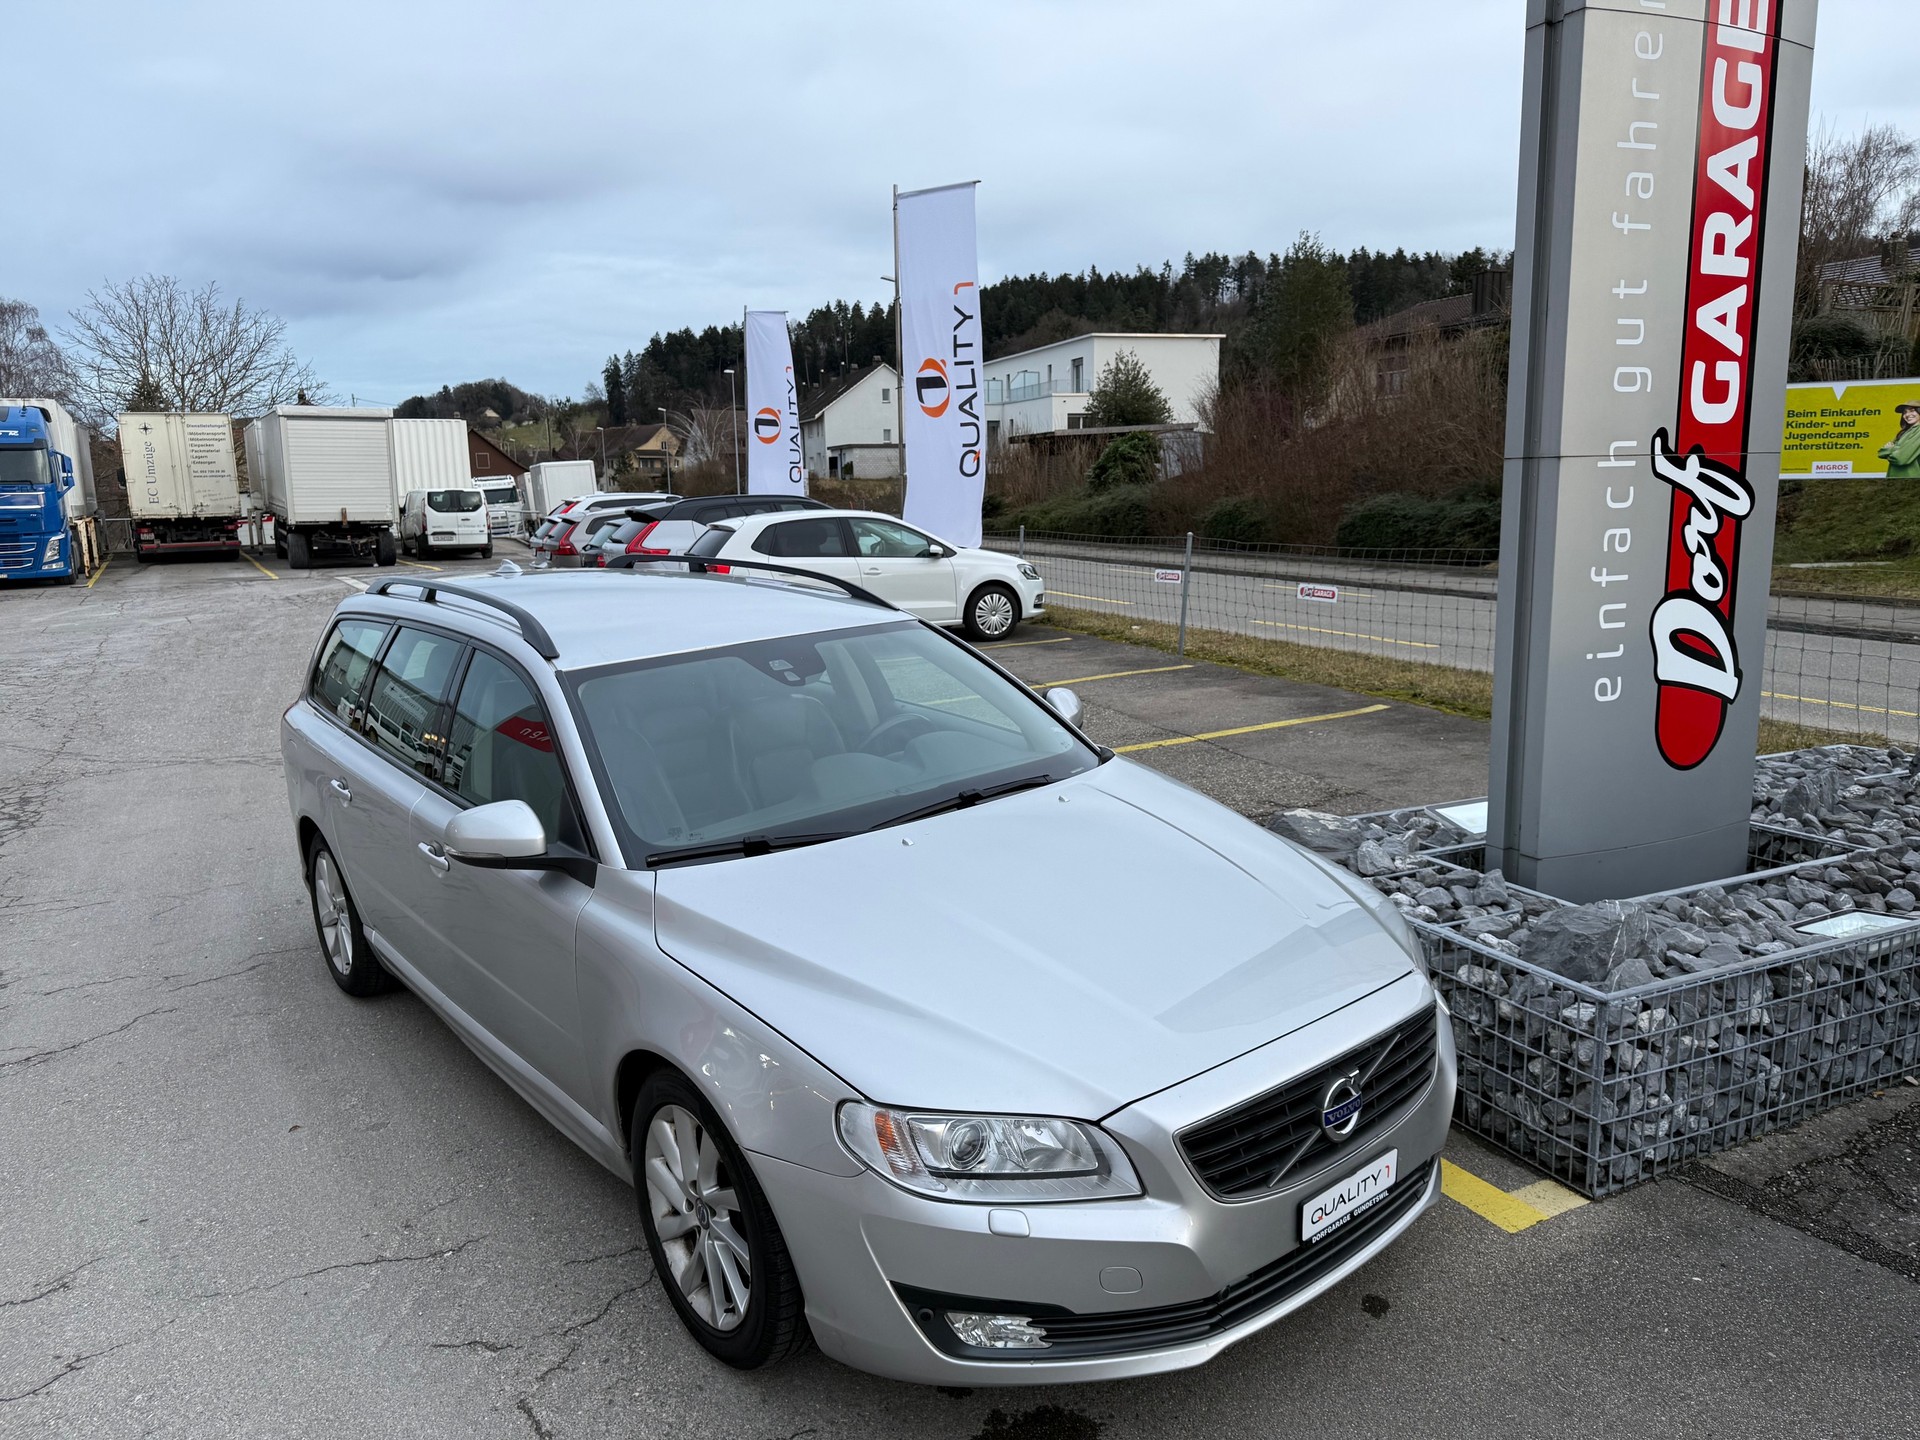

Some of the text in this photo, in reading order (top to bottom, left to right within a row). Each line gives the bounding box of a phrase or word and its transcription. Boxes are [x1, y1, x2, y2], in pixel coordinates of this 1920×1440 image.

[1611, 279, 1653, 393] gut
[1651, 0, 1770, 701] Dorf GARAGE
[953, 281, 981, 478] QUALITY 1
[1785, 431, 1870, 441] Jugendcamps
[1786, 419, 1856, 429] Kinder- und
[1787, 407, 1881, 418] Beim Einkaufen
[143, 441, 160, 504] EC Umzüge
[1784, 441, 1863, 451] unterstützen.
[1313, 589, 1333, 598] GARAGE
[1586, 440, 1637, 702] einfach
[1327, 1099, 1361, 1122] VOLVO
[1311, 1165, 1390, 1225] QUALITY 1
[1311, 1190, 1390, 1244] DORFGARAGE GUNDETSWIL
